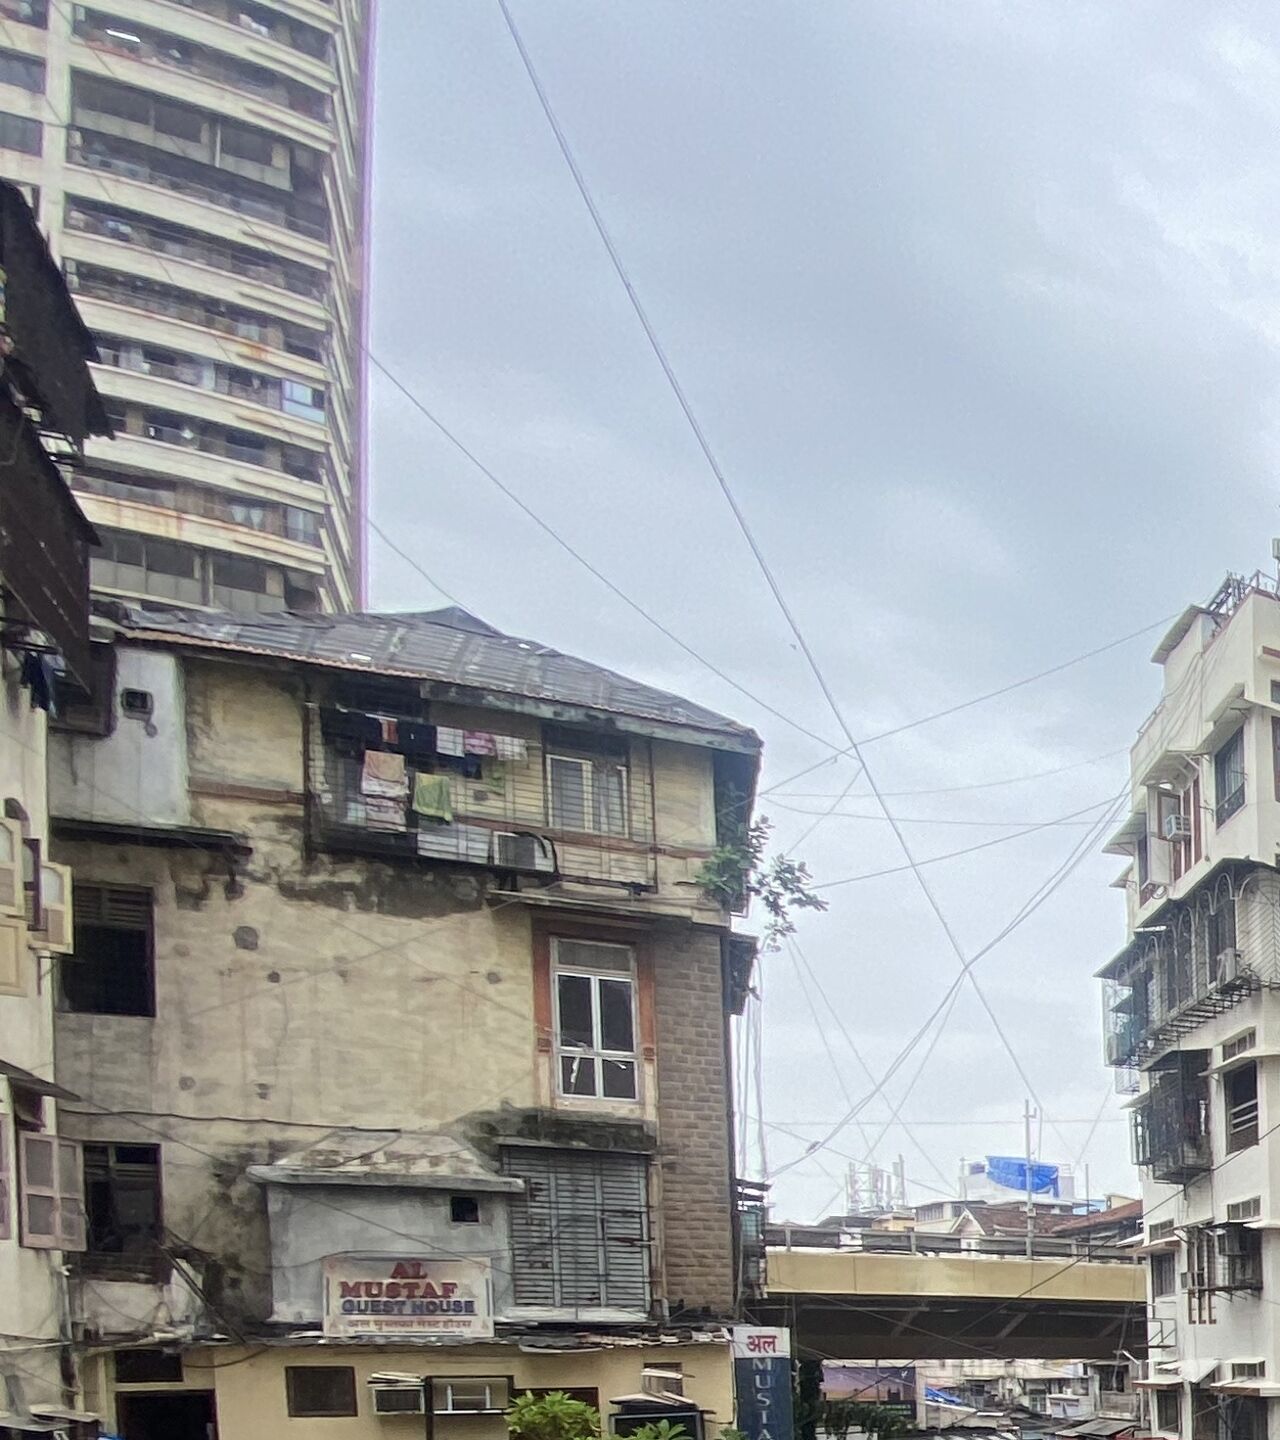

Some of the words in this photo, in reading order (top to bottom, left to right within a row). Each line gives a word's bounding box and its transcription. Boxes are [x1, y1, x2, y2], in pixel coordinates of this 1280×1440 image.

[391, 1262, 427, 1279] AL
[411, 1300, 475, 1313] HOUSE
[747, 1335, 777, 1353] अल
